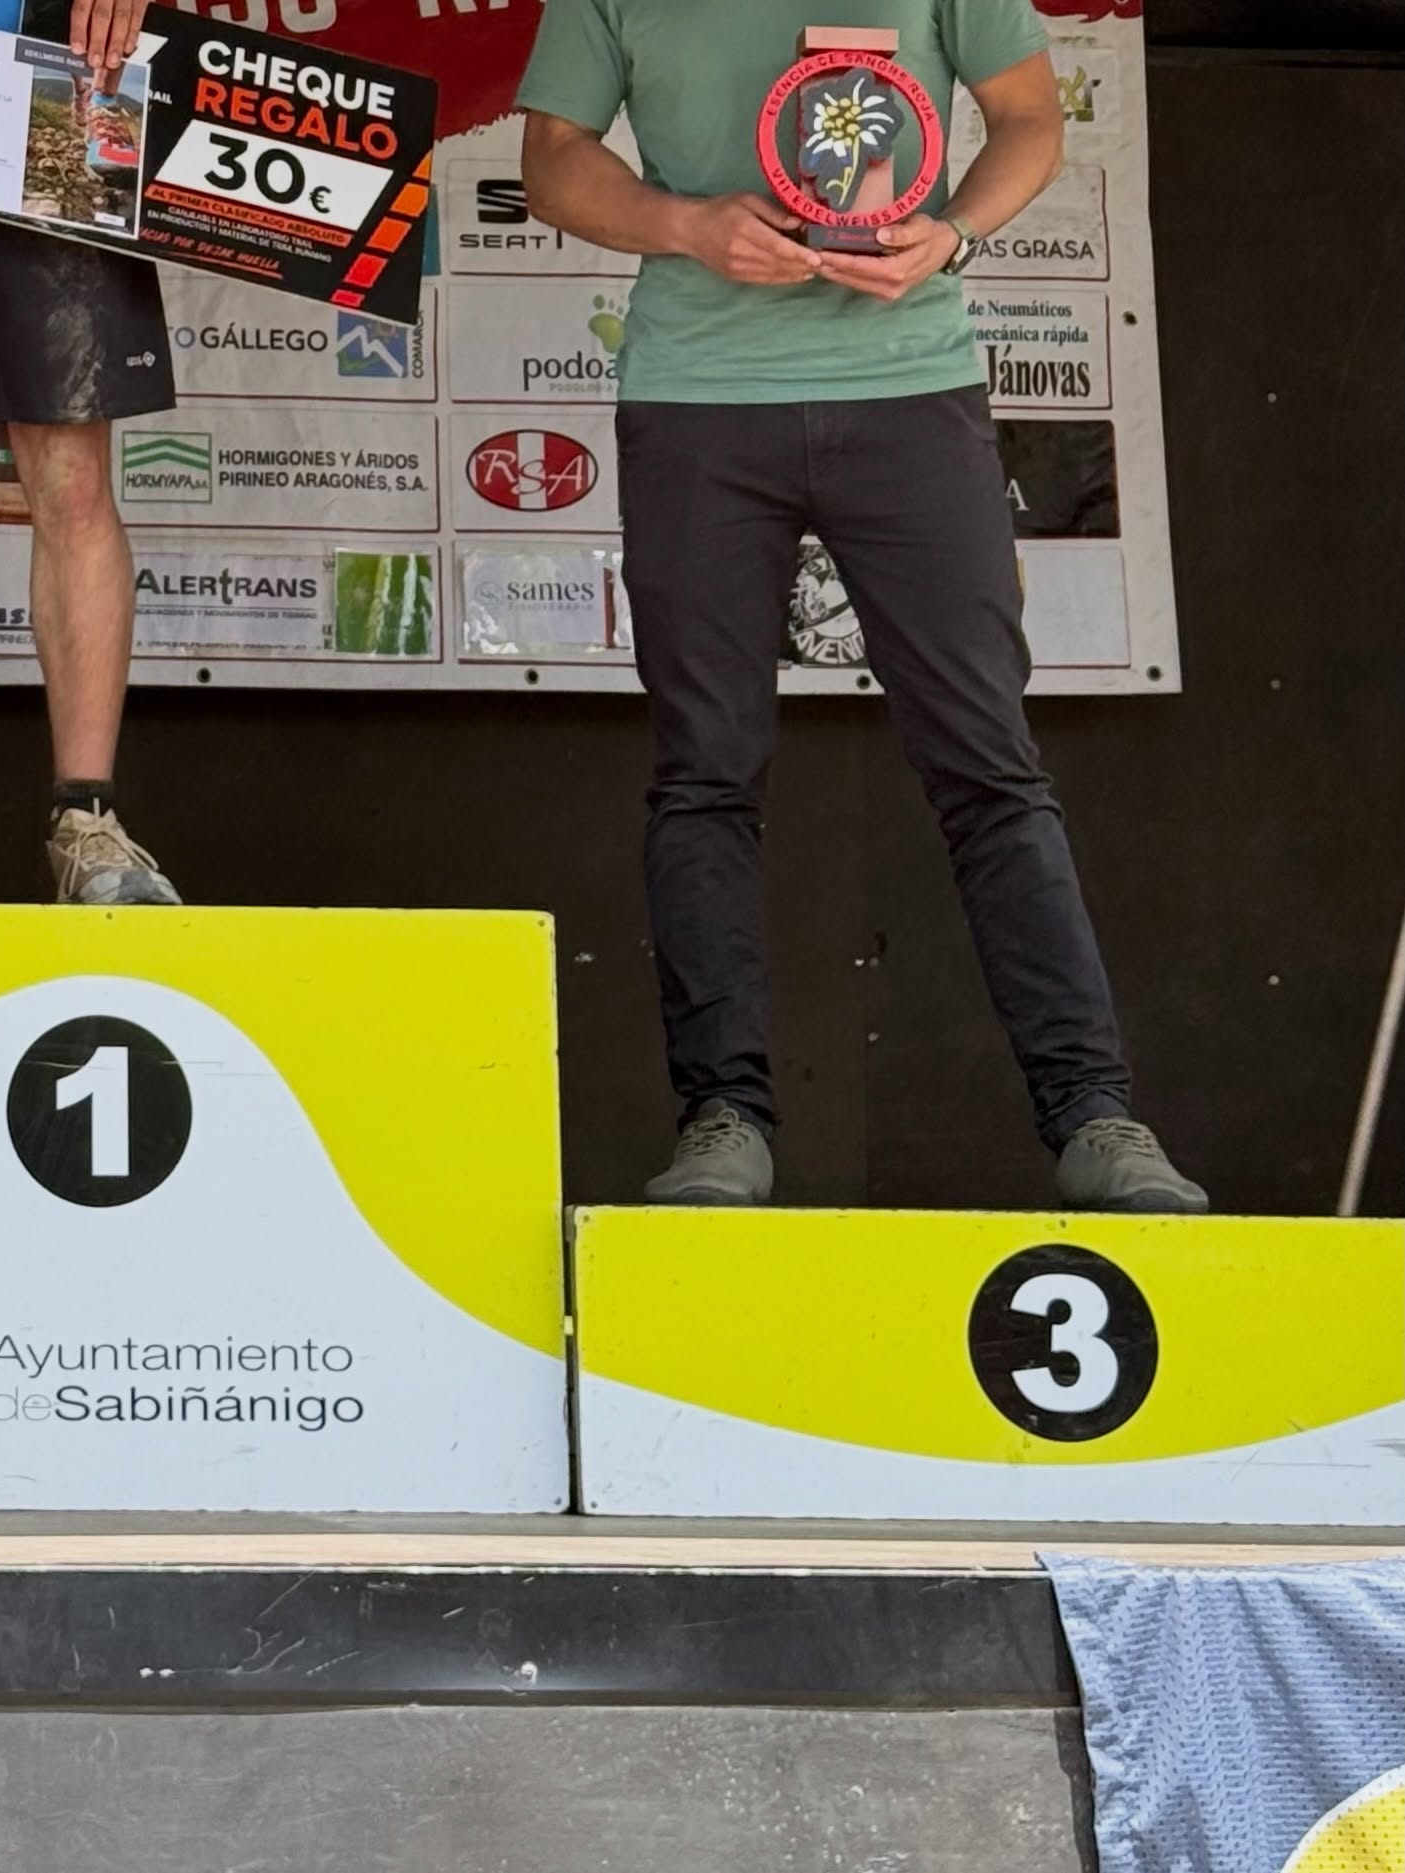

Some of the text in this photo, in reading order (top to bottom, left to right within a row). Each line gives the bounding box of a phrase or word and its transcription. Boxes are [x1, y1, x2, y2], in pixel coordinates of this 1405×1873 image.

[197, 39, 395, 120] CHEQUE
[767, 62, 814, 116] ESENCIA
[907, 83, 934, 121] ROJA
[194, 77, 398, 161] REGALO
[151, 187, 345, 243] AL PRIMER CLASIFICADO ABSOLUTO
[792, 195, 892, 227] EDELWEISS
[895, 175, 932, 213] RACE
[459, 233, 548, 249] SEAT
[978, 238, 1095, 260] AS GRASA
[967, 299, 1073, 318] de Neumáticos
[199, 322, 329, 353] GÁLLEGO
[1043, 325, 1089, 347] rápida
[522, 349, 618, 392] podoa
[985, 343, 1091, 398] Jánovas
[218, 449, 419, 470] HORMIGONES Y ÁRIDOS
[218, 471, 428, 493] PIRINEO ARAGONÉS, S.A.
[477, 448, 583, 497] RSA
[507, 580, 595, 602] sames
[55, 1045, 130, 1177] 1
[1009, 1273, 1119, 1413] 3
